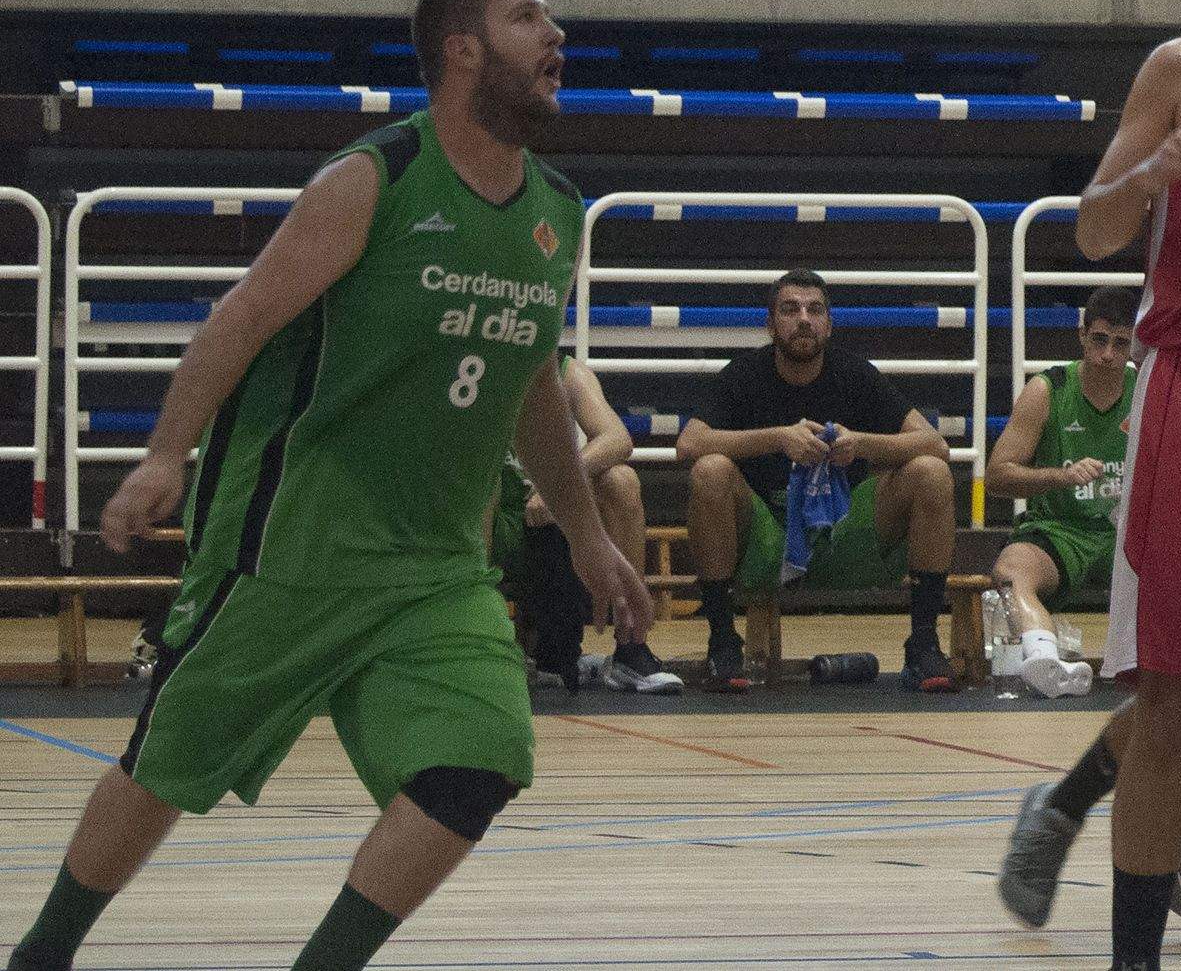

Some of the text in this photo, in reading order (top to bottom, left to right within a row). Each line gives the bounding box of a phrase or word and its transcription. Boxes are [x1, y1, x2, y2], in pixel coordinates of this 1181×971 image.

[421, 264, 557, 309] Cerdanyola
[438, 302, 539, 347] al dia
[449, 354, 486, 409] 8
